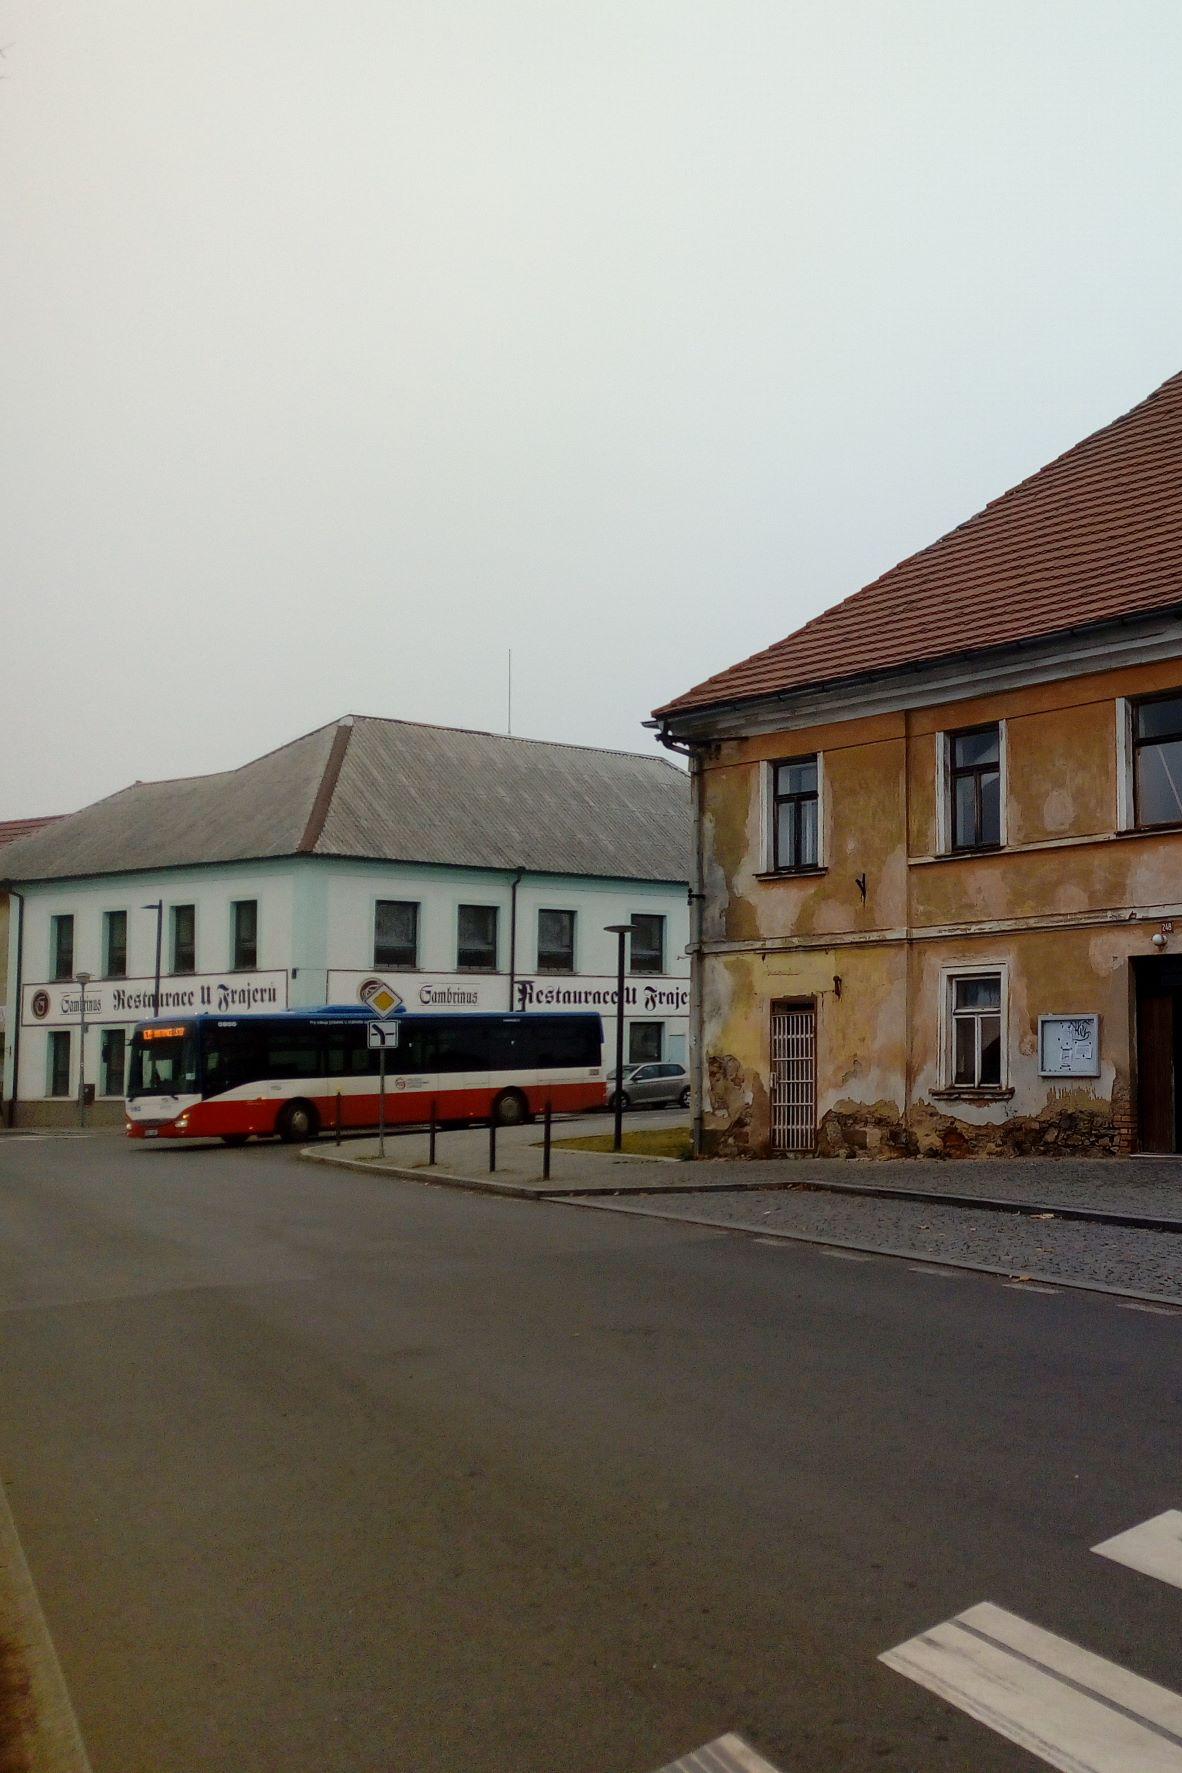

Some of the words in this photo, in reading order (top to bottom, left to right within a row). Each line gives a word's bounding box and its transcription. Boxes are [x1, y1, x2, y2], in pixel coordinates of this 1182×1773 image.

[1162, 922, 1172, 932] 248
[61, 994, 102, 1013] Gambrinus
[113, 988, 194, 1011] Restaurace
[201, 985, 211, 1006] U
[419, 985, 478, 1004] Gambrinus
[517, 983, 619, 1005] Restaurace
[624, 986, 637, 1005] U
[643, 985, 689, 1012] Fraje
